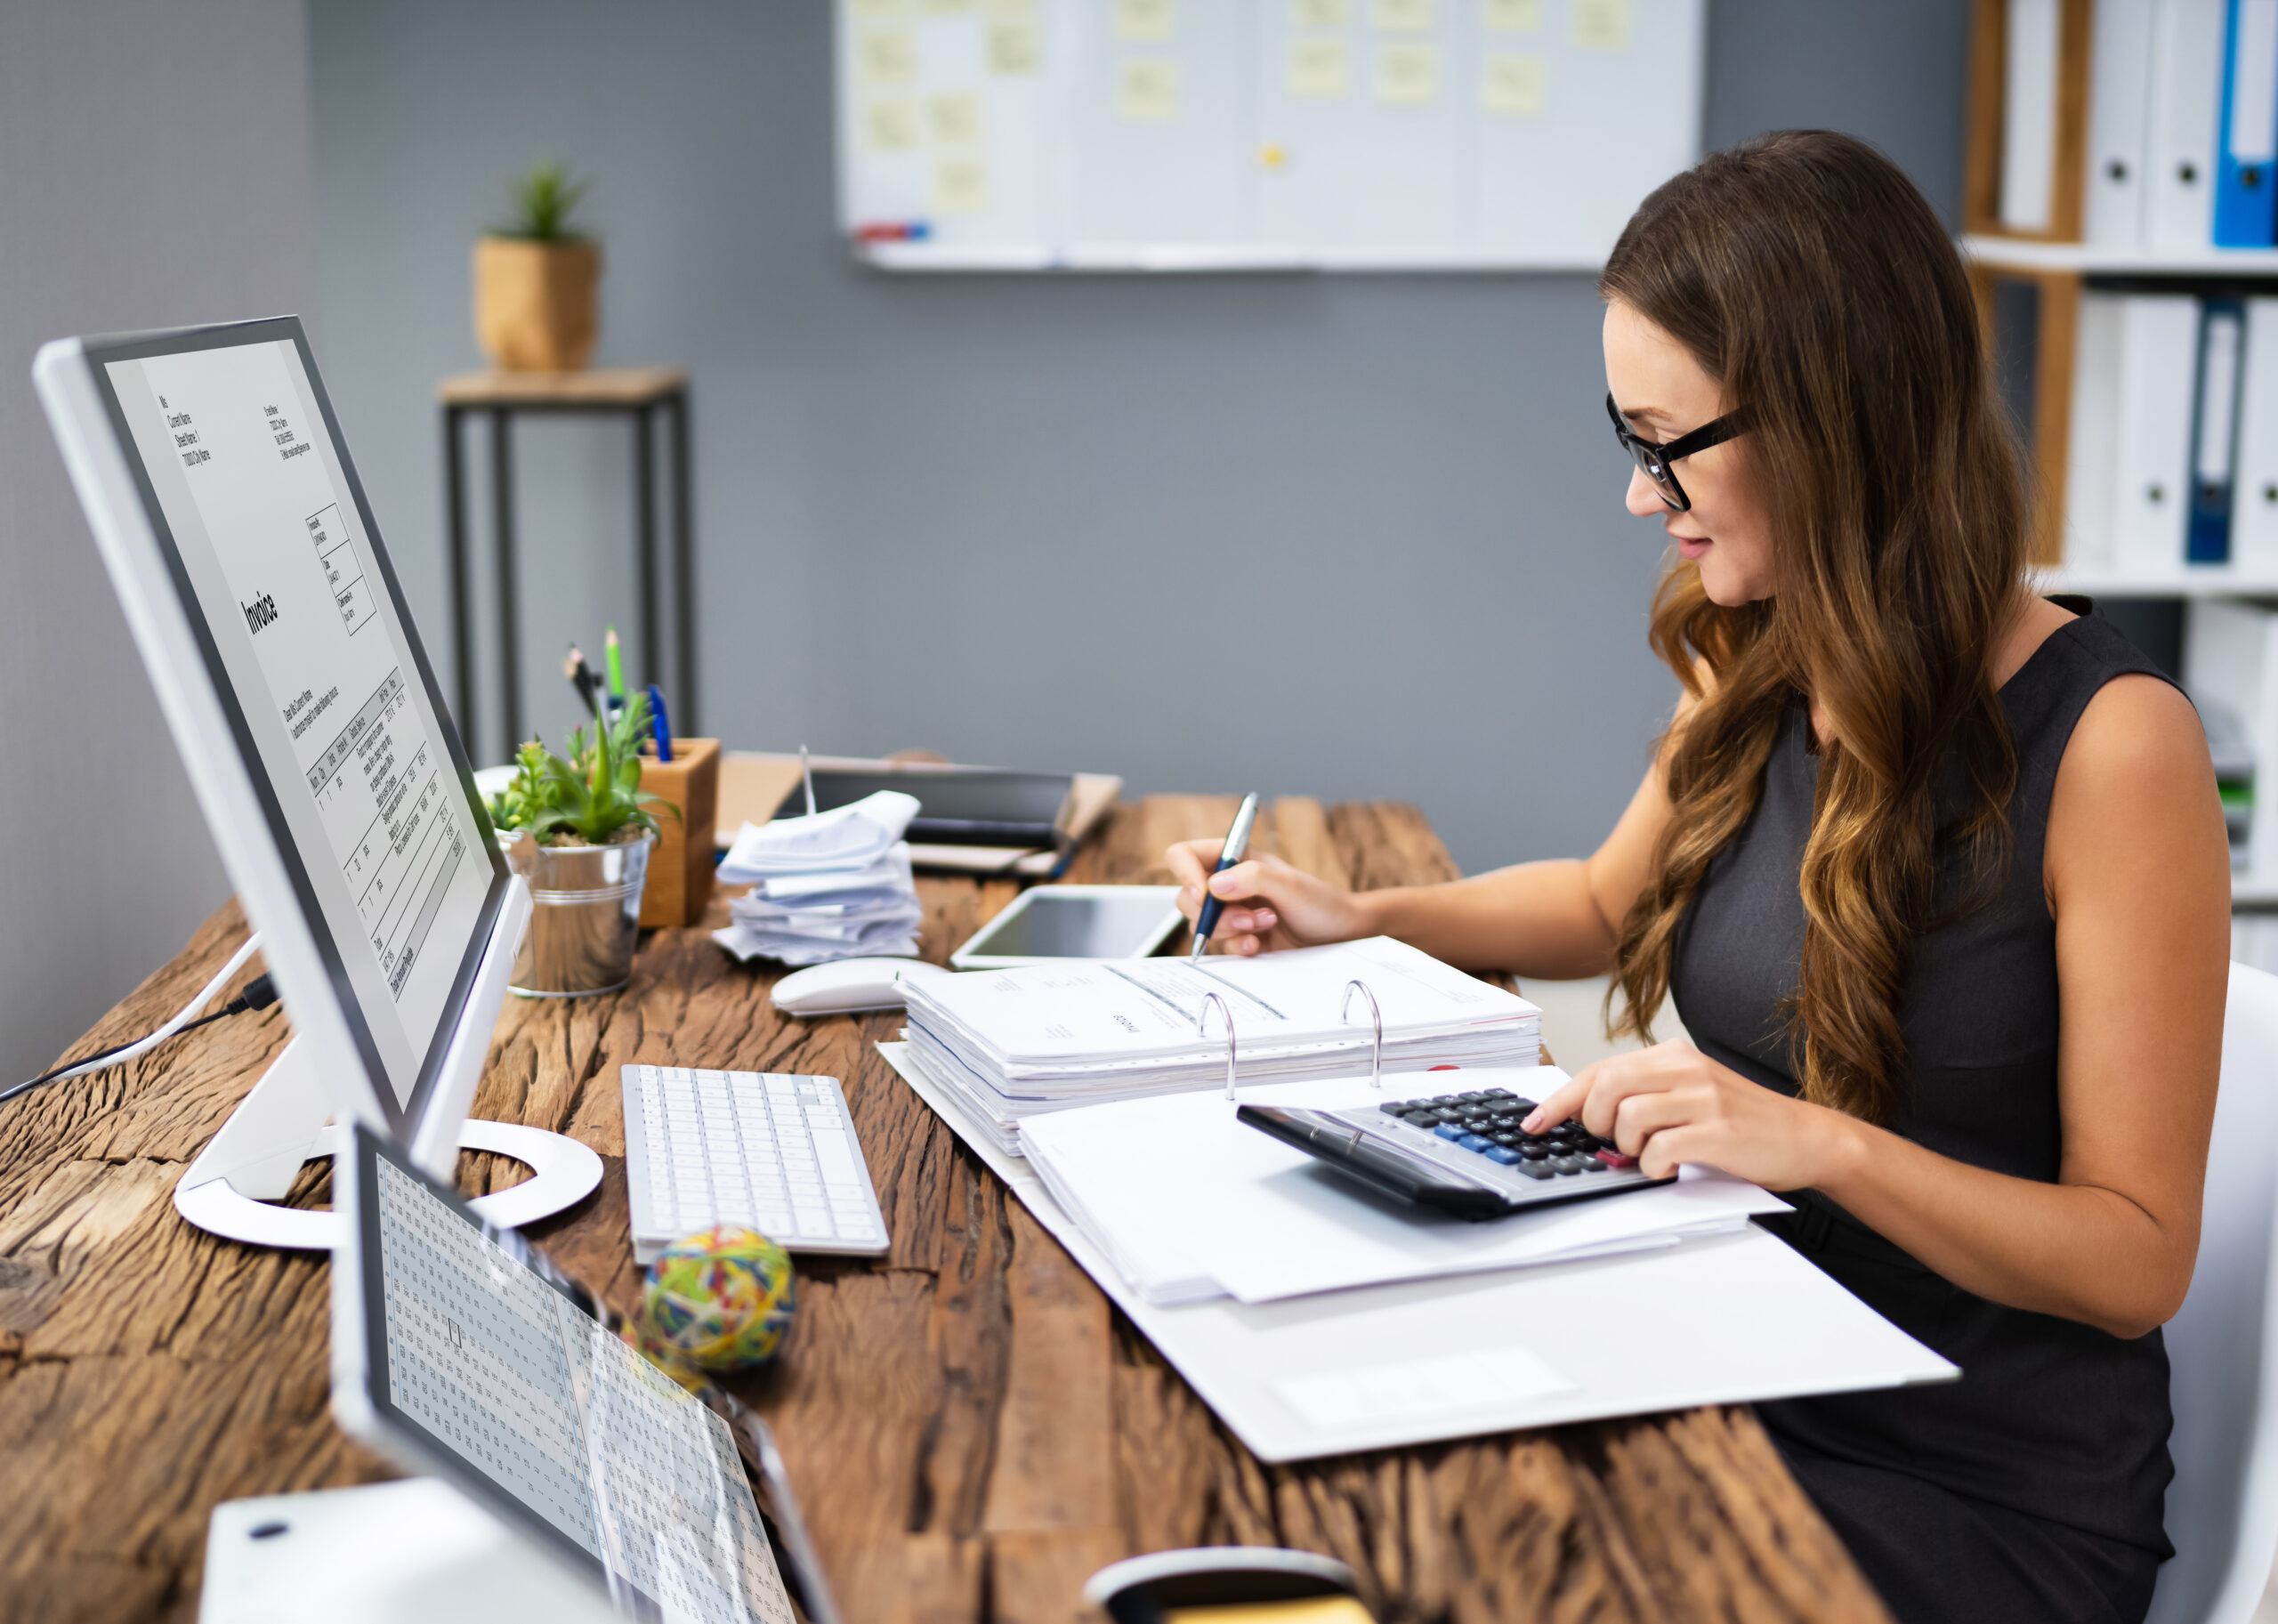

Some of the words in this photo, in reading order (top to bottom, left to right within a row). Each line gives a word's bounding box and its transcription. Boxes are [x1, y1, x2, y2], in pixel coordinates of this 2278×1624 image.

[178, 412, 192, 425] Name
[174, 433, 188, 448] Street
[184, 432, 198, 445] Name
[198, 449, 211, 461] Name
[240, 591, 278, 635] Invoice
[283, 708, 293, 723] Dear
[288, 703, 297, 716] Ms
[293, 695, 306, 712] Current
